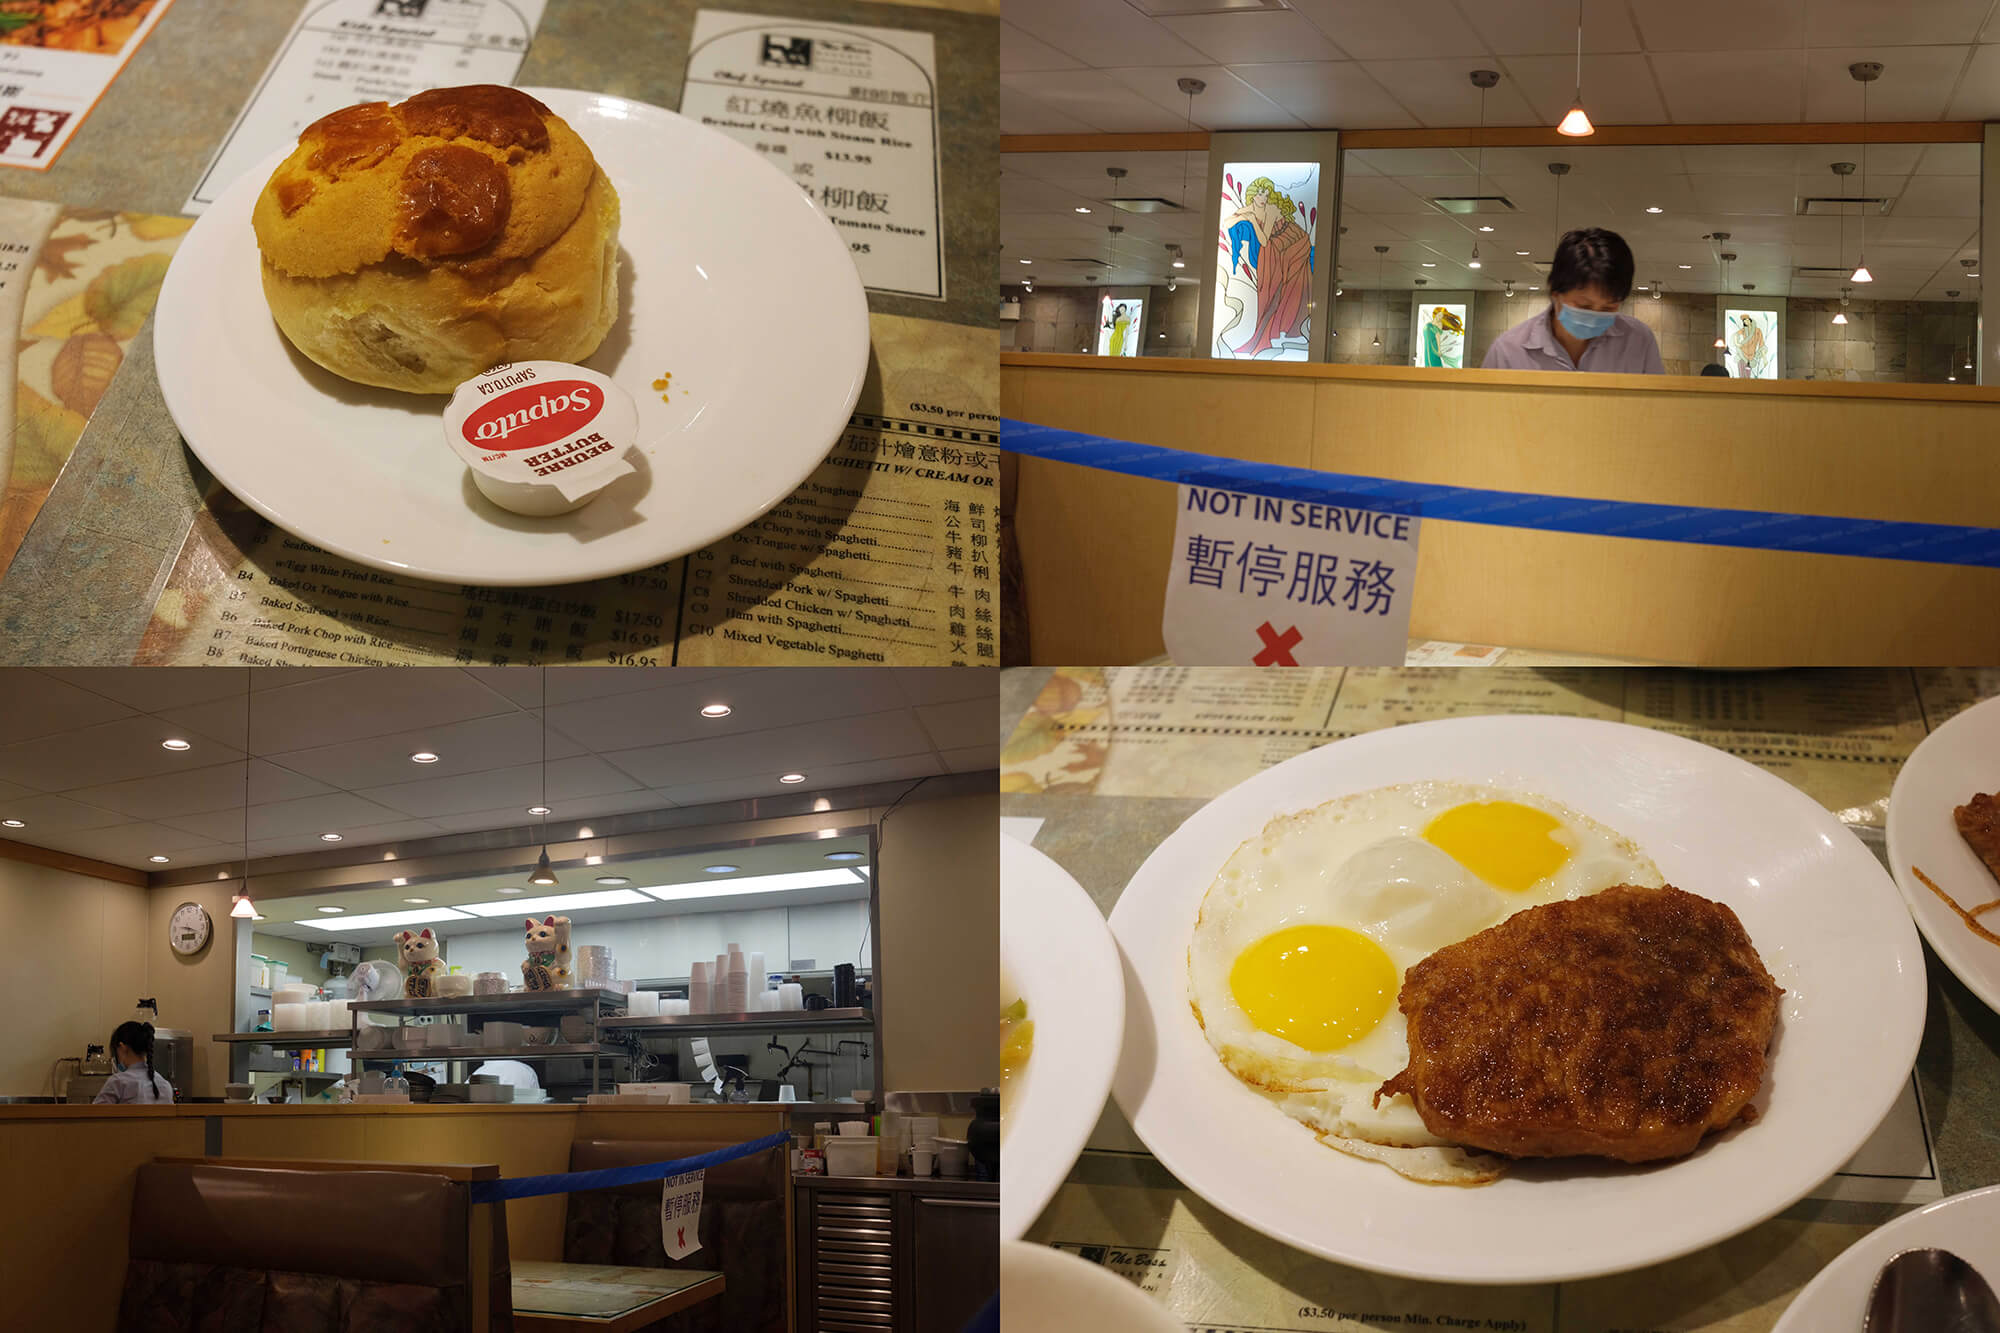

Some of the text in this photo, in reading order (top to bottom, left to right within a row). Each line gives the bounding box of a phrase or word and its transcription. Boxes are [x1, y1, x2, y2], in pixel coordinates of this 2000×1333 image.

[725, 94, 890, 131] 紅燒魚柳飯
[702, 115, 912, 149] Braised Cod with Steam Rice
[824, 150, 872, 165] $13.95
[829, 215, 926, 237] Tomato Sauce
[477, 367, 536, 395] SAPUTO.CA
[474, 388, 591, 441] Saputo
[910, 401, 944, 415] ($3.50
[946, 408, 965, 418] per
[524, 432, 605, 467] BUTTER
[534, 441, 615, 477] BEURRE
[823, 455, 994, 487] AGHETTI W/ CREAM OR
[812, 482, 863, 498] Spaghetti
[796, 510, 848, 527] Spaghetti
[1186, 487, 1410, 541] NOT IN SERVICE
[732, 533, 797, 551] Ox-Tongue
[817, 544, 871, 561] Spaghetti
[762, 520, 793, 536] Chop
[796, 526, 822, 538] with
[824, 531, 877, 548] Spaghetti
[309, 564, 340, 578] White
[341, 568, 368, 584] Fried
[370, 573, 394, 585] Rice
[730, 554, 757, 568] Beef
[760, 559, 785, 571] with
[788, 563, 843, 580] Spaghetti
[1186, 534, 1396, 616] 暫停服務
[237, 569, 410, 608] B4 Baked Ox Tongue with Rice
[728, 574, 783, 590] Shredded
[786, 581, 813, 596] Pork
[817, 588, 834, 598] w/
[835, 589, 889, 606] Spaghetti
[228, 591, 247, 602] B5
[260, 596, 293, 611] Baked
[341, 609, 364, 623] with
[366, 614, 391, 628] Rice
[614, 608, 664, 629] $17.50
[726, 607, 753, 622] Ham
[757, 612, 783, 625] with
[786, 616, 843, 635] Spaghetti
[727, 591, 781, 609] Shredded
[785, 599, 833, 617] Chicken
[836, 607, 853, 618] w/
[855, 610, 910, 628] Spaghetti
[220, 610, 238, 623] B6
[287, 622, 310, 637] Pork
[313, 627, 342, 643] Chop
[343, 631, 367, 646] with
[369, 636, 393, 649] Rice
[610, 627, 660, 647] $16.95
[688, 623, 885, 663] C10 Mixed Vegetable Spaghetti
[206, 646, 225, 658] B8
[239, 652, 273, 667] Baked
[213, 628, 384, 667] B7 Baked Portuguese Chicken
[608, 651, 657, 667] $16.95
[665, 1176, 678, 1189] NOT
[678, 1174, 685, 1186] IN
[1109, 1251, 1167, 1267] The Boss
[1299, 1306, 1528, 1333] ($3.50 per person Min. Charge Apply)
